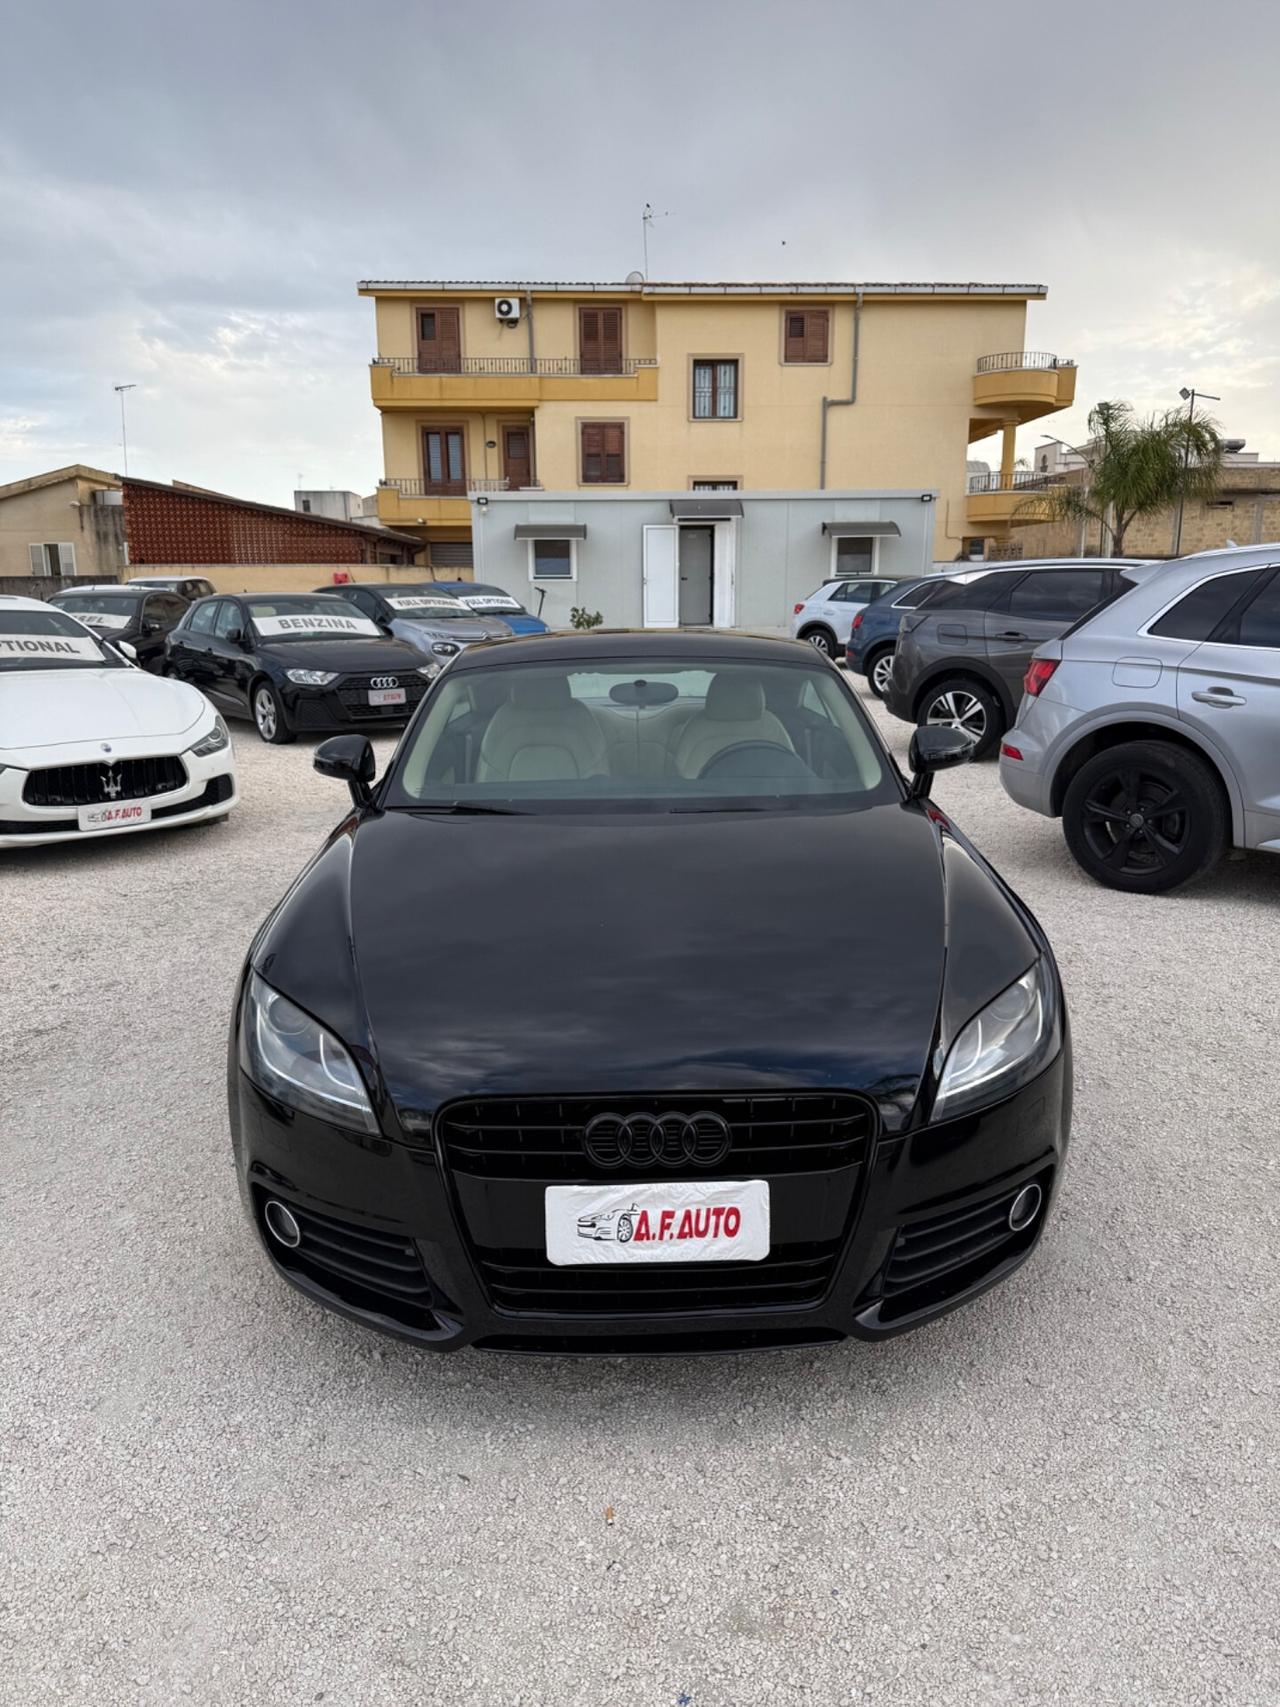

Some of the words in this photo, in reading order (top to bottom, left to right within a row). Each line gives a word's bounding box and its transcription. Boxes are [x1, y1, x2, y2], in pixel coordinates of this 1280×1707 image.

[74, 615, 104, 623] SEL
[278, 618, 357, 630] BENZINA
[0, 640, 80, 653] TIONAL
